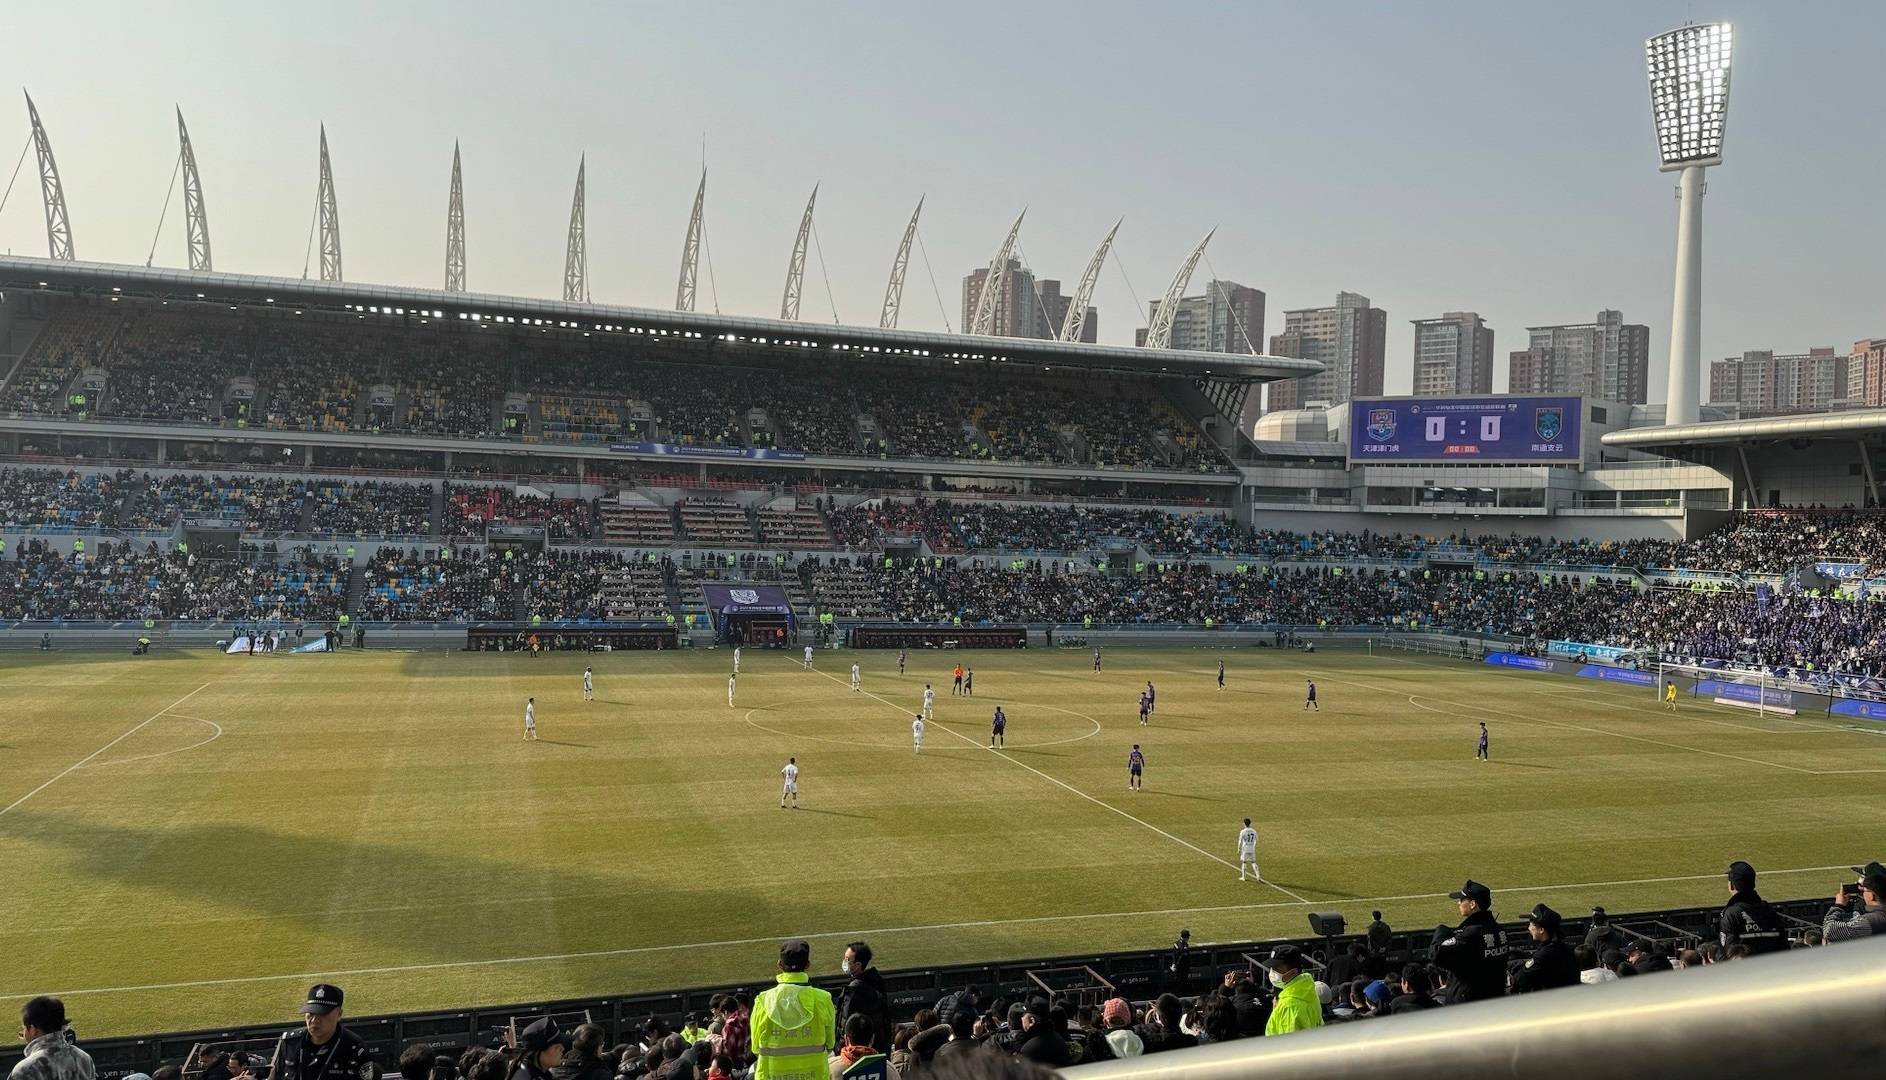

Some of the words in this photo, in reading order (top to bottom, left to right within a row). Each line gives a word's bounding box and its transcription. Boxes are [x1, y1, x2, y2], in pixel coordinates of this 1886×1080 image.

[1425, 416, 1446, 441] 0
[1480, 415, 1502, 441] 0
[1362, 444, 1400, 453] 天津津门虎
[1531, 443, 1564, 452] 南通支云
